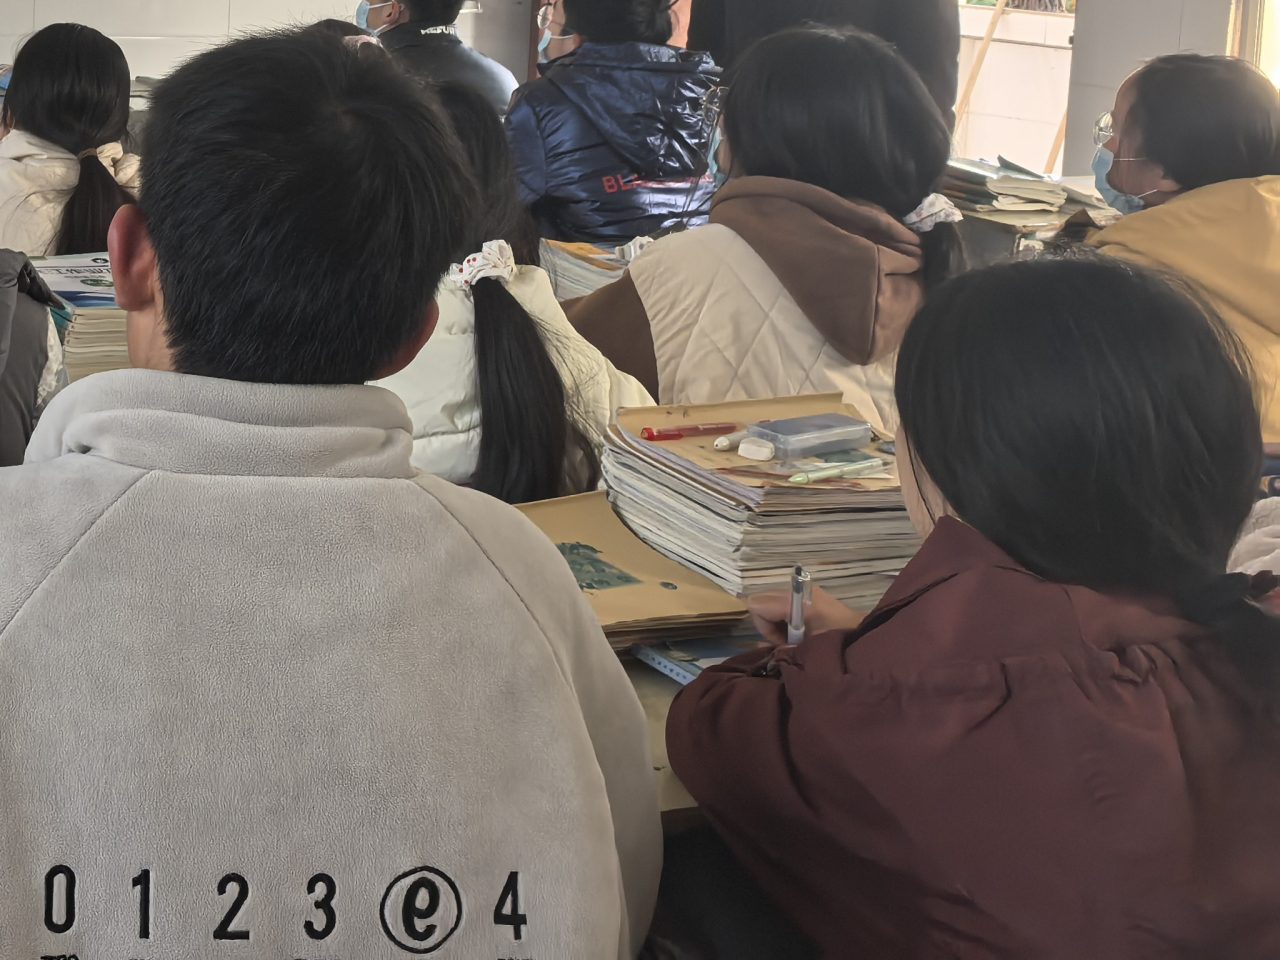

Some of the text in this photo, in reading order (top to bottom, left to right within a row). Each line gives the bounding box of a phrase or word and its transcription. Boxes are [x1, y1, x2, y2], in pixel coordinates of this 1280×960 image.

[43, 864, 76, 934] 0
[132, 869, 151, 939] 1
[212, 872, 250, 940] 2
[303, 872, 337, 940] 3
[494, 871, 527, 940] 4
